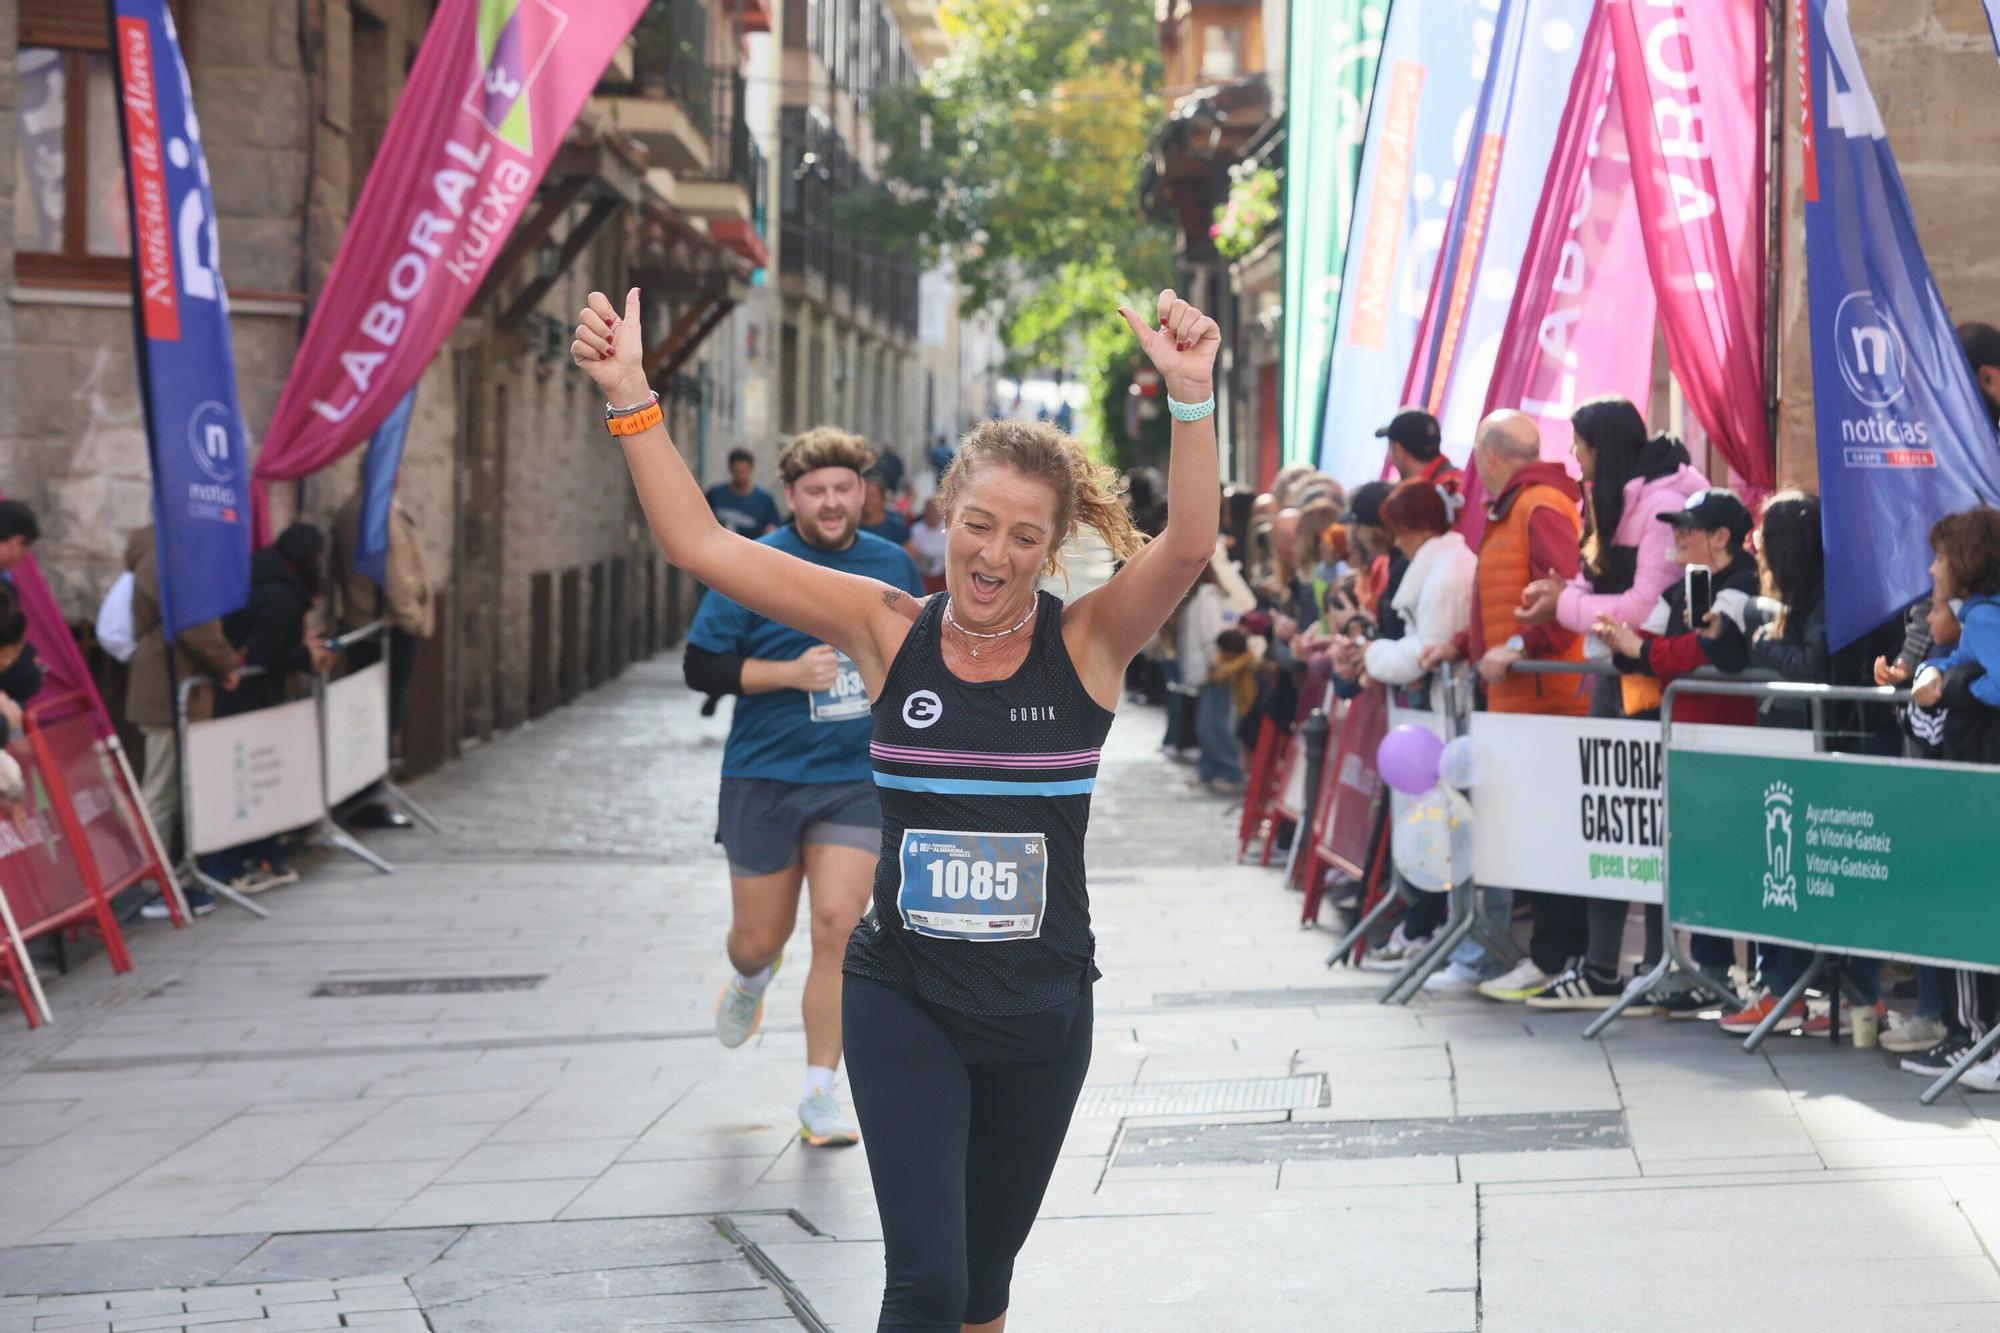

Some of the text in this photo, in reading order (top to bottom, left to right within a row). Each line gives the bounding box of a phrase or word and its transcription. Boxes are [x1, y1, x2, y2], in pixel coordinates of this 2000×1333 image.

[132, 133, 159, 172] de
[446, 157, 532, 284] kutxa
[141, 178, 172, 306] Noticias
[310, 140, 491, 423] LABORAL
[1841, 412, 1928, 444] noticias
[1010, 706, 1056, 722] GOBIK
[1579, 737, 1662, 789] VITORIA
[1806, 803, 1874, 828] Ayuntamiento
[1024, 843, 1039, 855] 5K
[1806, 826, 1891, 853] de Vitoria-Gasteiz
[926, 859, 1018, 901] 1085
[1589, 853, 1663, 884] green capit
[1806, 853, 1889, 881] Vitoria-Gasteizko
[1807, 876, 1835, 898] Udala
